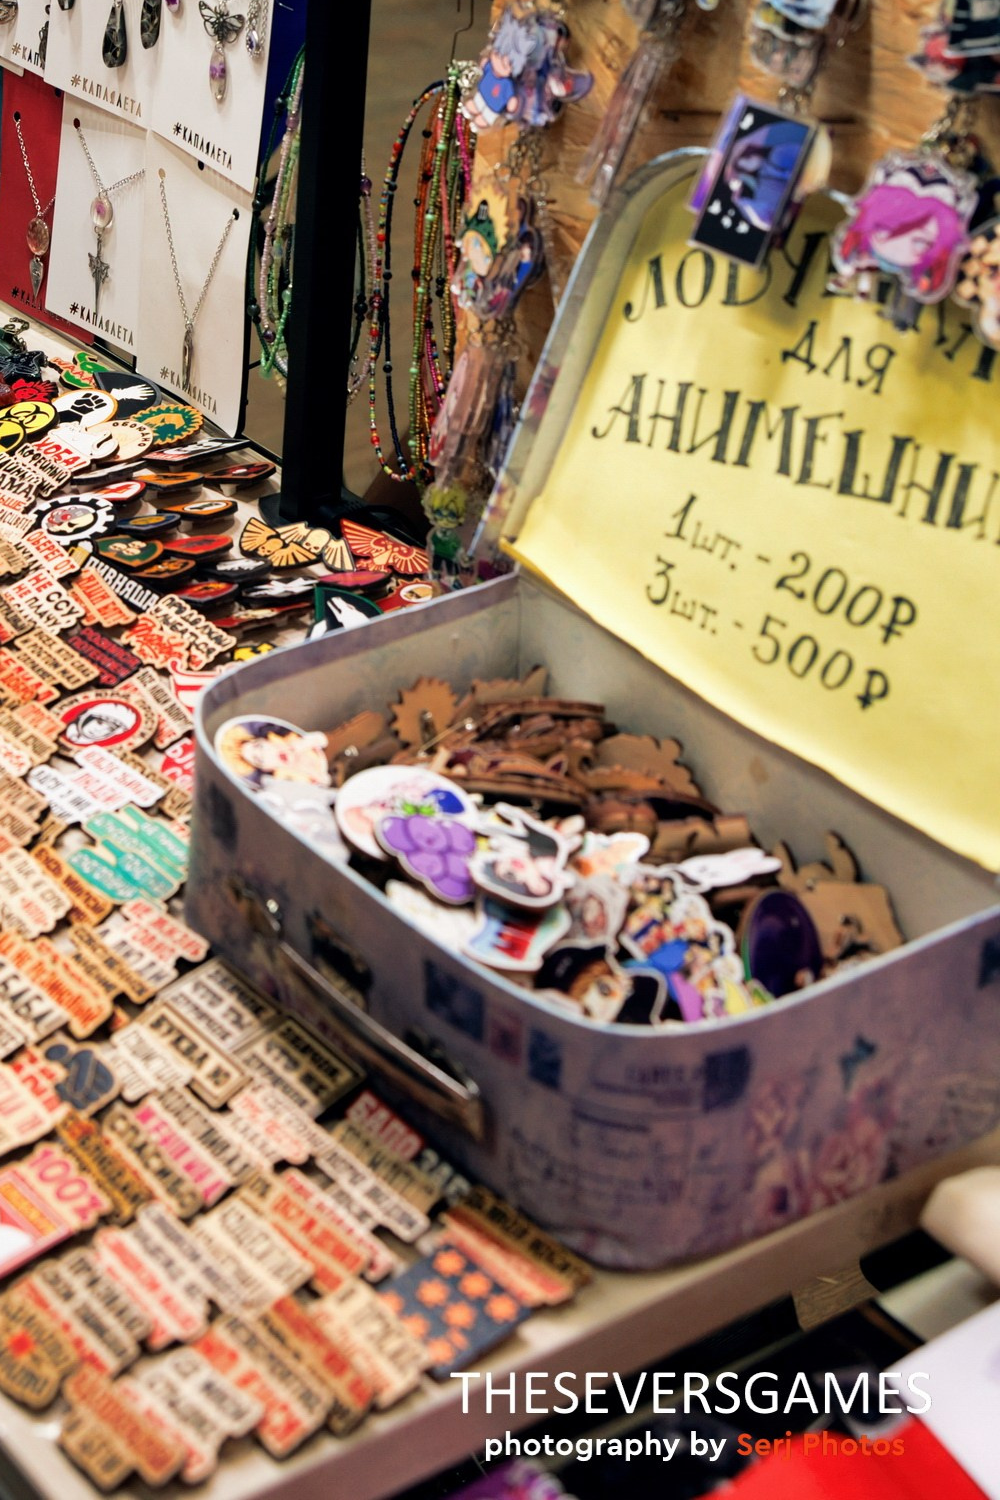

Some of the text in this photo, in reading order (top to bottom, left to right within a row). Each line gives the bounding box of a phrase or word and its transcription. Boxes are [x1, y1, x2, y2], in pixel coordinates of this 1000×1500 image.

[781, 320, 896, 394] ДЛЯ
[33, 436, 86, 471] ХОБА!
[112, 421, 151, 448] ОБОЮДНО
[591, 374, 1000, 546] АНИМЕШНИ
[26, 530, 75, 575] ОБЕРЕГ ОТ
[13, 583, 32, 599] НЕ
[28, 571, 54, 593] НЕ
[84, 556, 161, 611] ПИВНЯША
[31, 1148, 101, 1222] 100%
